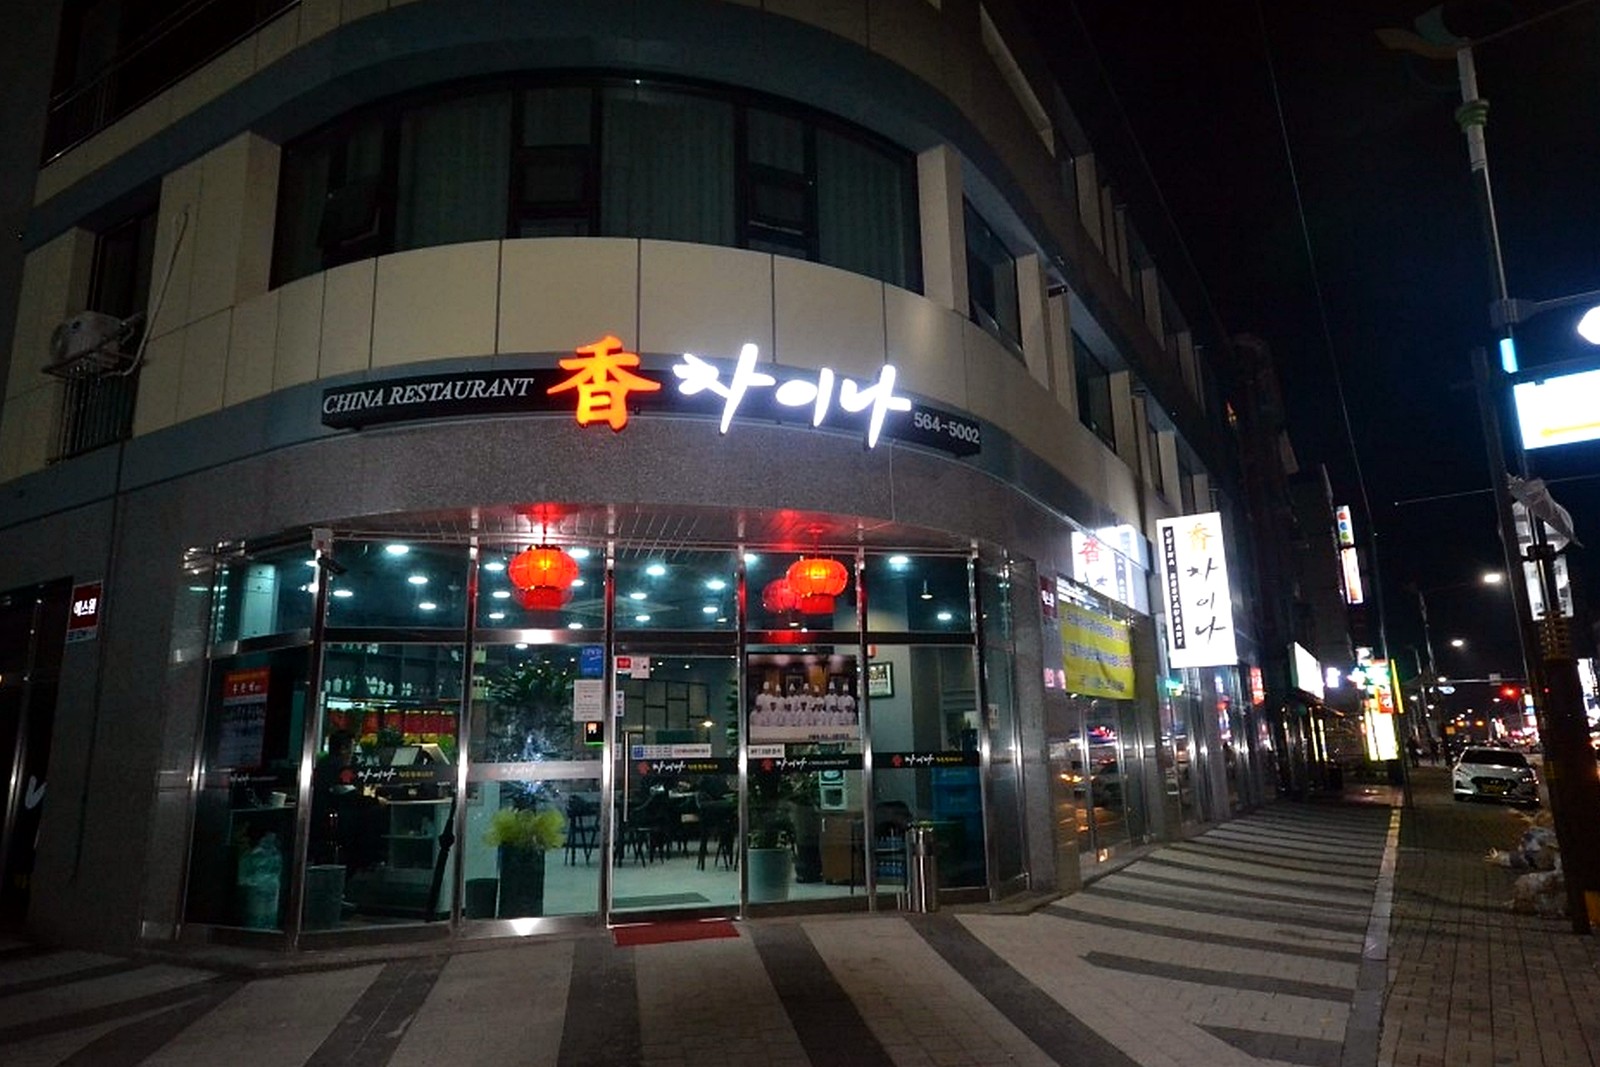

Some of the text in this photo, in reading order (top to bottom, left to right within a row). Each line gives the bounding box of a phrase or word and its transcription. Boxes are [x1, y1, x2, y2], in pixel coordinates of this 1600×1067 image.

[323, 377, 535, 414] CHINA RESTAURANT
[546, 335, 661, 433] 香
[672, 342, 912, 449] 차이나
[914, 411, 981, 444] 564-5002
